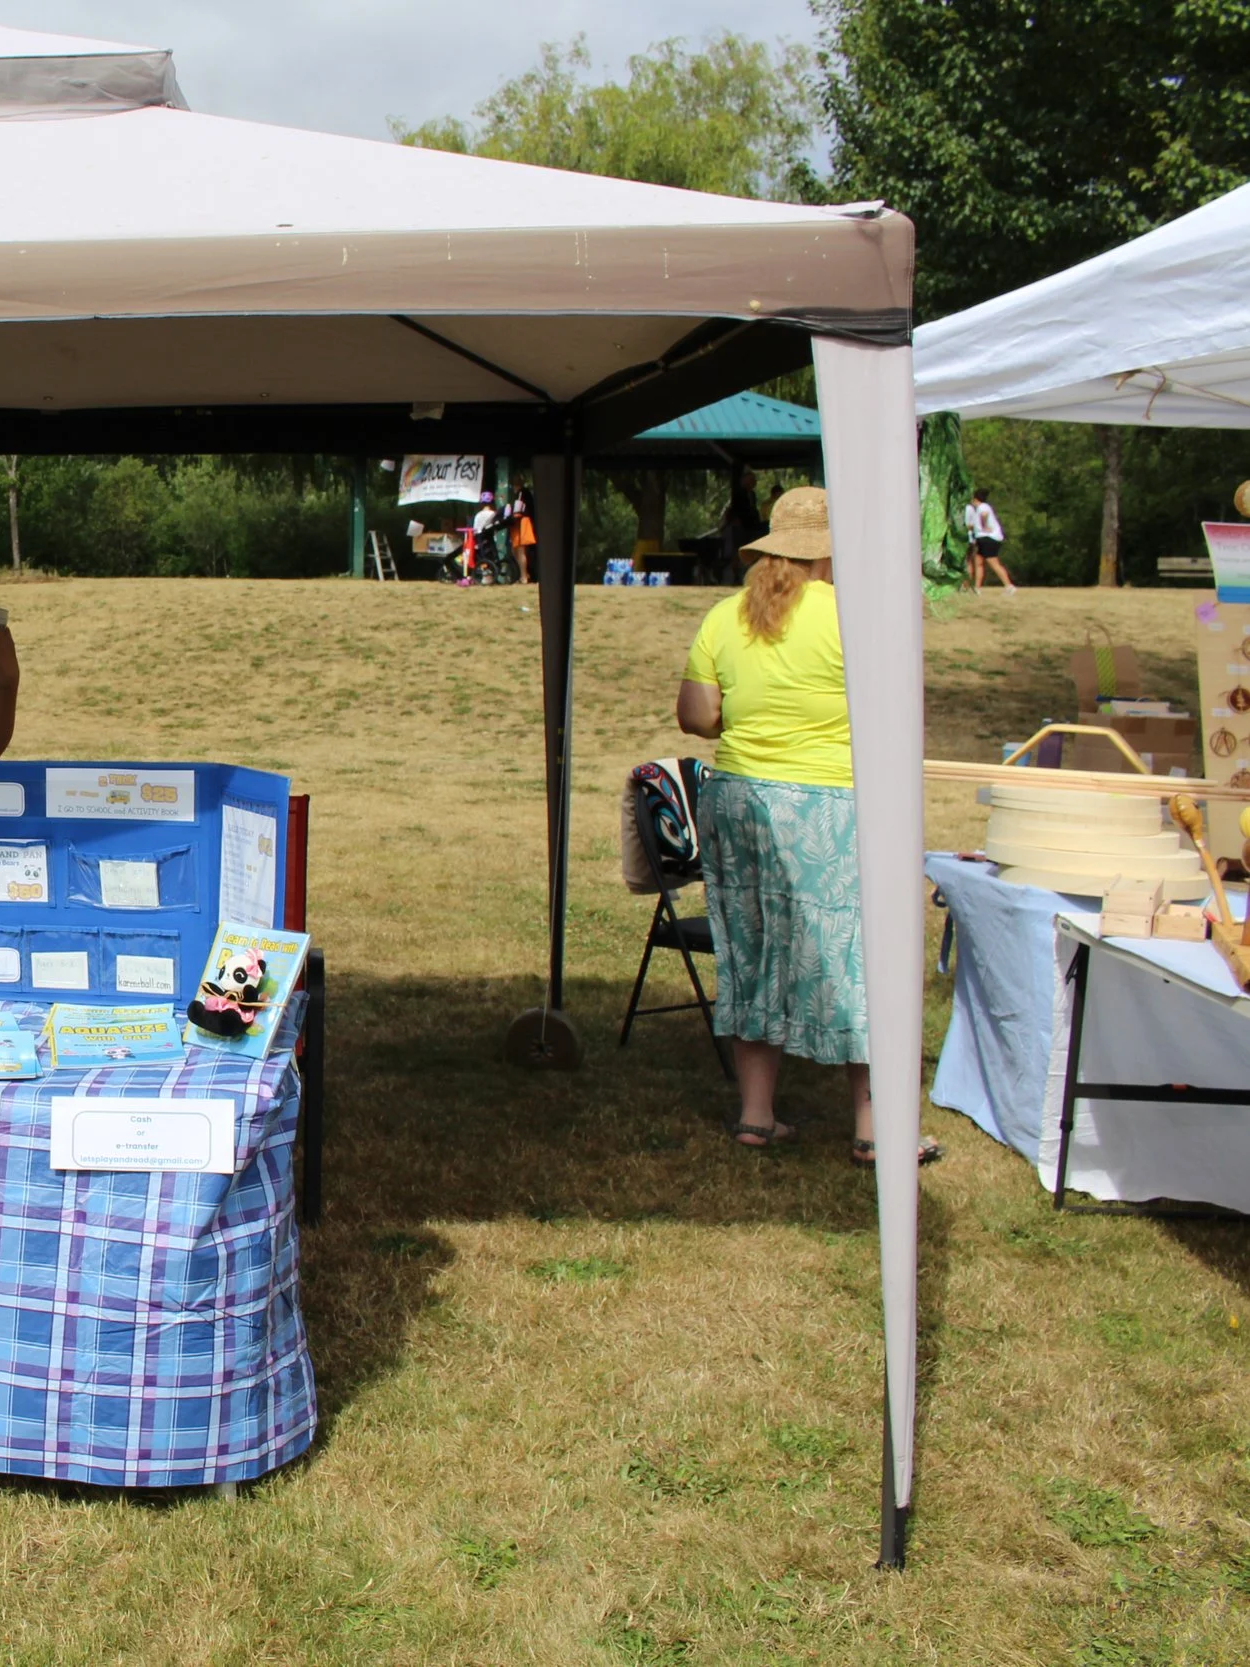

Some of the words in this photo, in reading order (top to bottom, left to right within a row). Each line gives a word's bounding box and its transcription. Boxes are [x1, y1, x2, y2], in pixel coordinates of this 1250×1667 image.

[87, 806, 112, 814] SCHOOL
[128, 807, 160, 816] ACTIVITY
[161, 808, 179, 816] BOOK
[23, 851, 42, 859] PAN
[222, 931, 247, 946] Learn
[59, 1023, 168, 1035] AQUASIZE
[116, 1142, 159, 1150] e-transfer
[80, 1155, 203, 1166] letsplayandread@gmail.com
